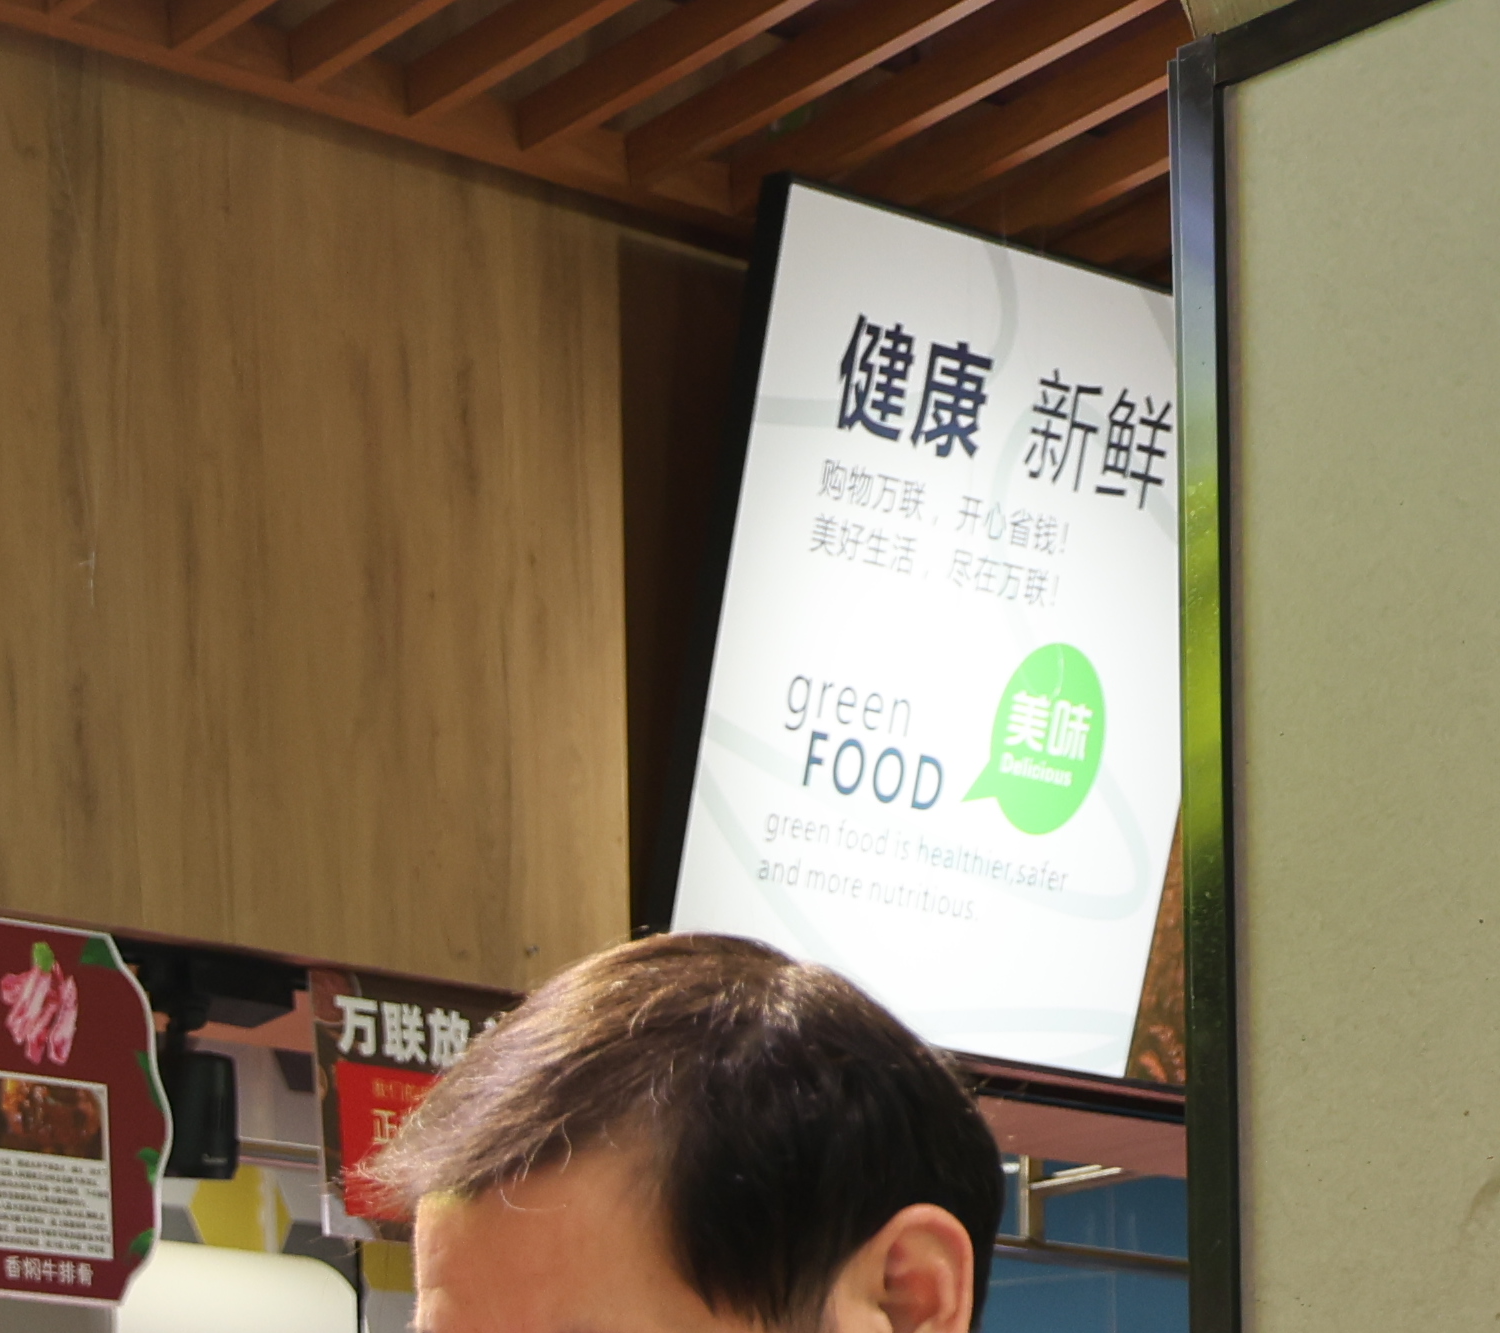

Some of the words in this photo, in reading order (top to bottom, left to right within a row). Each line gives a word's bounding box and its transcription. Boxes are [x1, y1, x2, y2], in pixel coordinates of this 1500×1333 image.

[837, 313, 994, 459] 健康
[1023, 368, 1174, 511] 新鲜
[785, 674, 912, 737] green
[1005, 691, 1091, 766] 美味
[802, 730, 944, 811] FOOD
[999, 752, 1072, 788] Delicious
[758, 855, 798, 889] and
[805, 871, 862, 902] more
[867, 874, 980, 924] nutritious.
[764, 811, 831, 855] green
[839, 820, 889, 860] food
[894, 830, 912, 861] is
[915, 832, 1069, 894] healthier,safer
[333, 994, 498, 1067] 万联放
